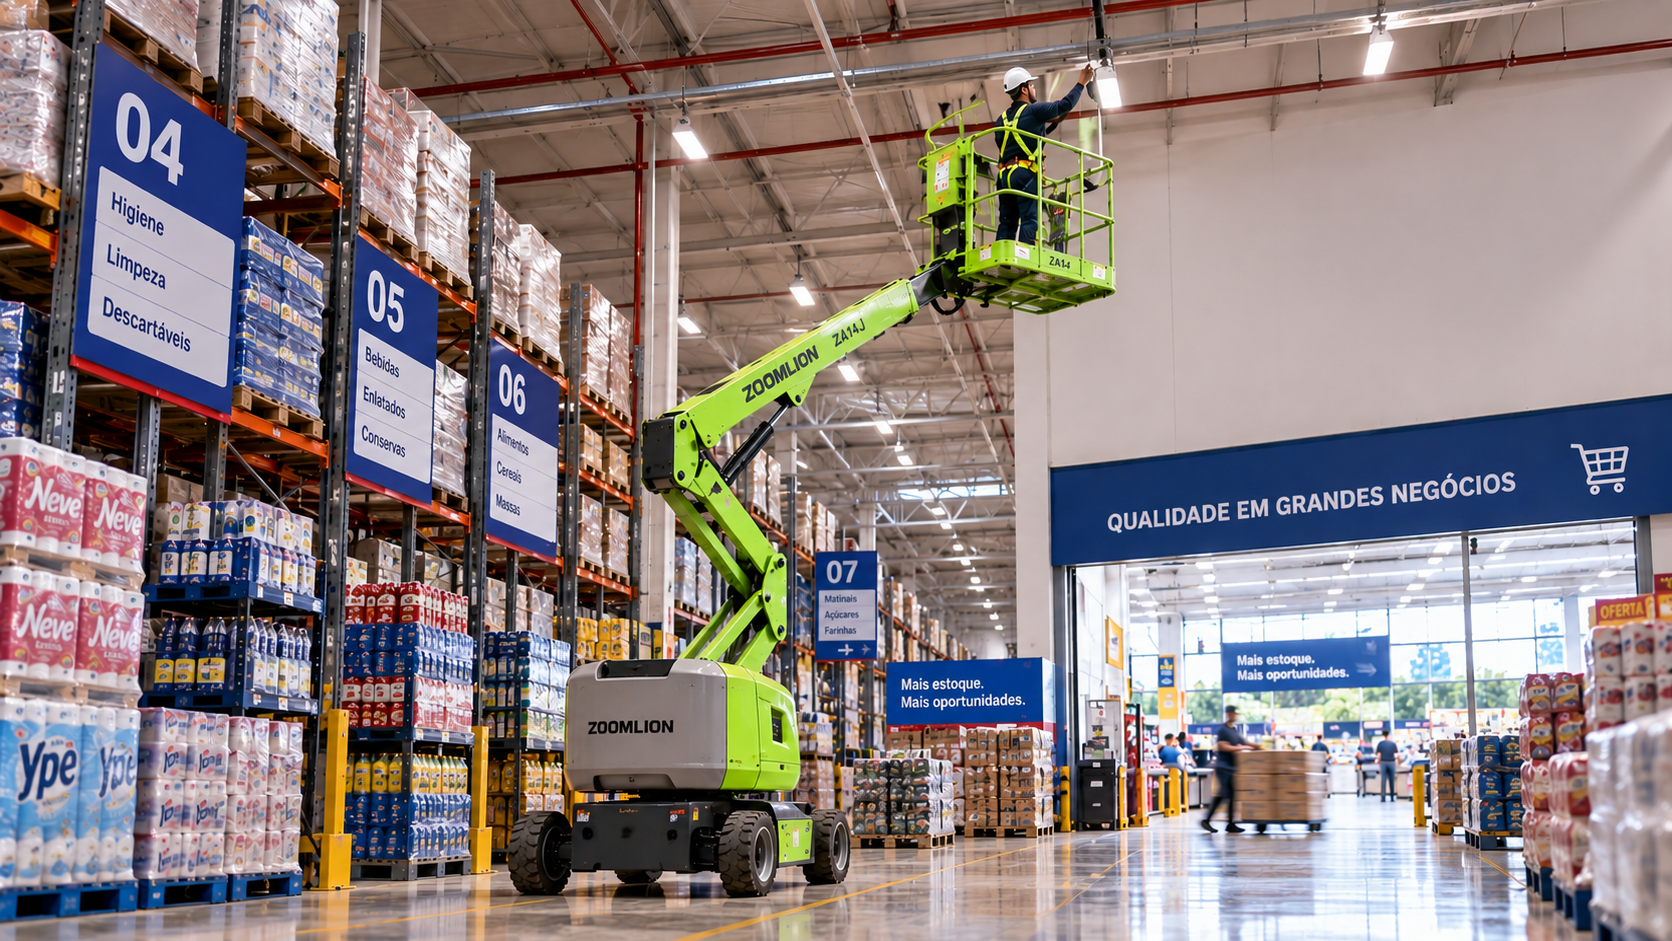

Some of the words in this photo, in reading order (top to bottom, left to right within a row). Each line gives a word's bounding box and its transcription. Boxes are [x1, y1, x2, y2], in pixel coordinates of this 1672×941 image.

[116, 92, 184, 186] 04
[111, 191, 165, 236] Higiene
[107, 244, 166, 289] Limpeza
[367, 270, 405, 333] 05
[103, 296, 191, 352] Descartáveis
[365, 346, 400, 378] Bebidas
[741, 345, 819, 403] ZOOMLION
[831, 318, 866, 348] ZA14J
[363, 385, 406, 419] Enlatados
[499, 364, 526, 415] 06
[361, 425, 406, 458] Conservas
[497, 428, 529, 456] Alimentos
[496, 460, 522, 484] Cereais
[24, 475, 82, 518] Neve
[495, 493, 521, 516] Massas
[1107, 502, 1231, 534] QUALIDADE
[1237, 498, 1269, 520] EM
[1276, 485, 1384, 516] GRANDES
[1391, 471, 1516, 504] NEGÓCIOS
[93, 497, 143, 536] Neve
[826, 560, 858, 584] 07
[824, 595, 857, 603] Matinais
[824, 610, 859, 620] Açúcares
[1600, 602, 1644, 619] OFERTA
[16, 603, 75, 642] Neve
[88, 615, 141, 652] Neve
[824, 626, 857, 635] Farinhas
[1237, 654, 1263, 666] Mais
[1266, 654, 1315, 667] estoque.
[1237, 669, 1263, 681] Mais
[1266, 666, 1350, 682] oportunidades.
[901, 678, 930, 690] Mais
[932, 678, 984, 693] estoque.
[901, 696, 930, 708] Mais
[933, 693, 1026, 711] oportunidades.
[588, 720, 674, 735] ZOOMLION
